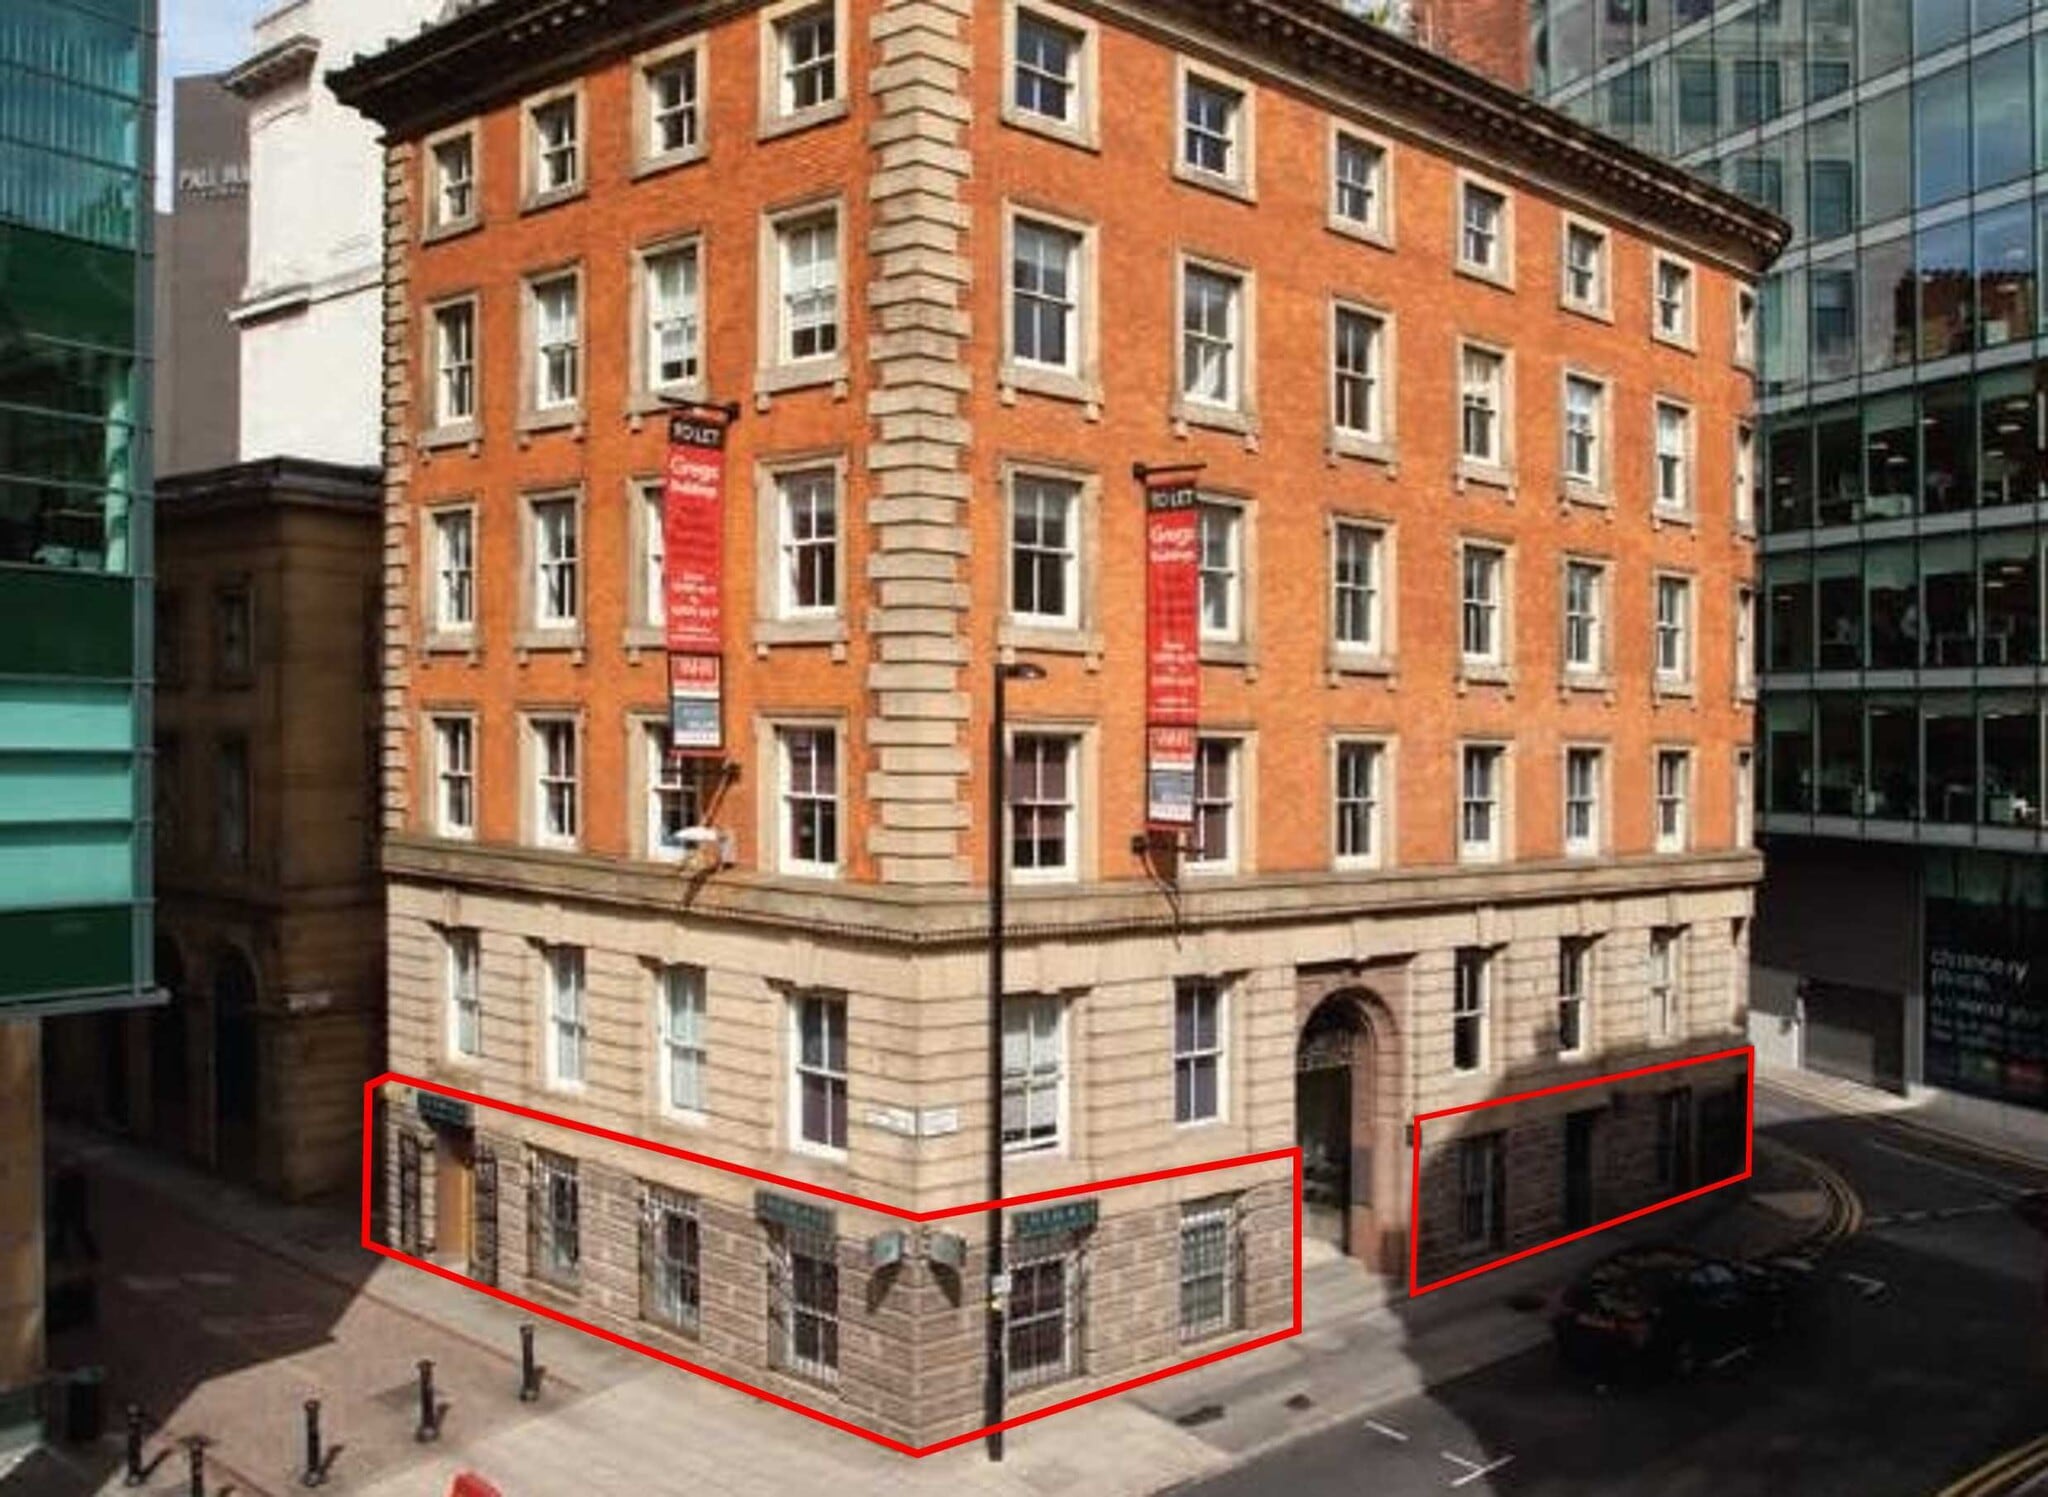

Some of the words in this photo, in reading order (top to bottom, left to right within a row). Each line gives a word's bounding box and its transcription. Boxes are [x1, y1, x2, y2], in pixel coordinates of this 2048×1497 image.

[673, 421, 693, 440] TO
[694, 427, 721, 445] LET
[1151, 491, 1169, 508] TO
[1170, 489, 1193, 508] LET
